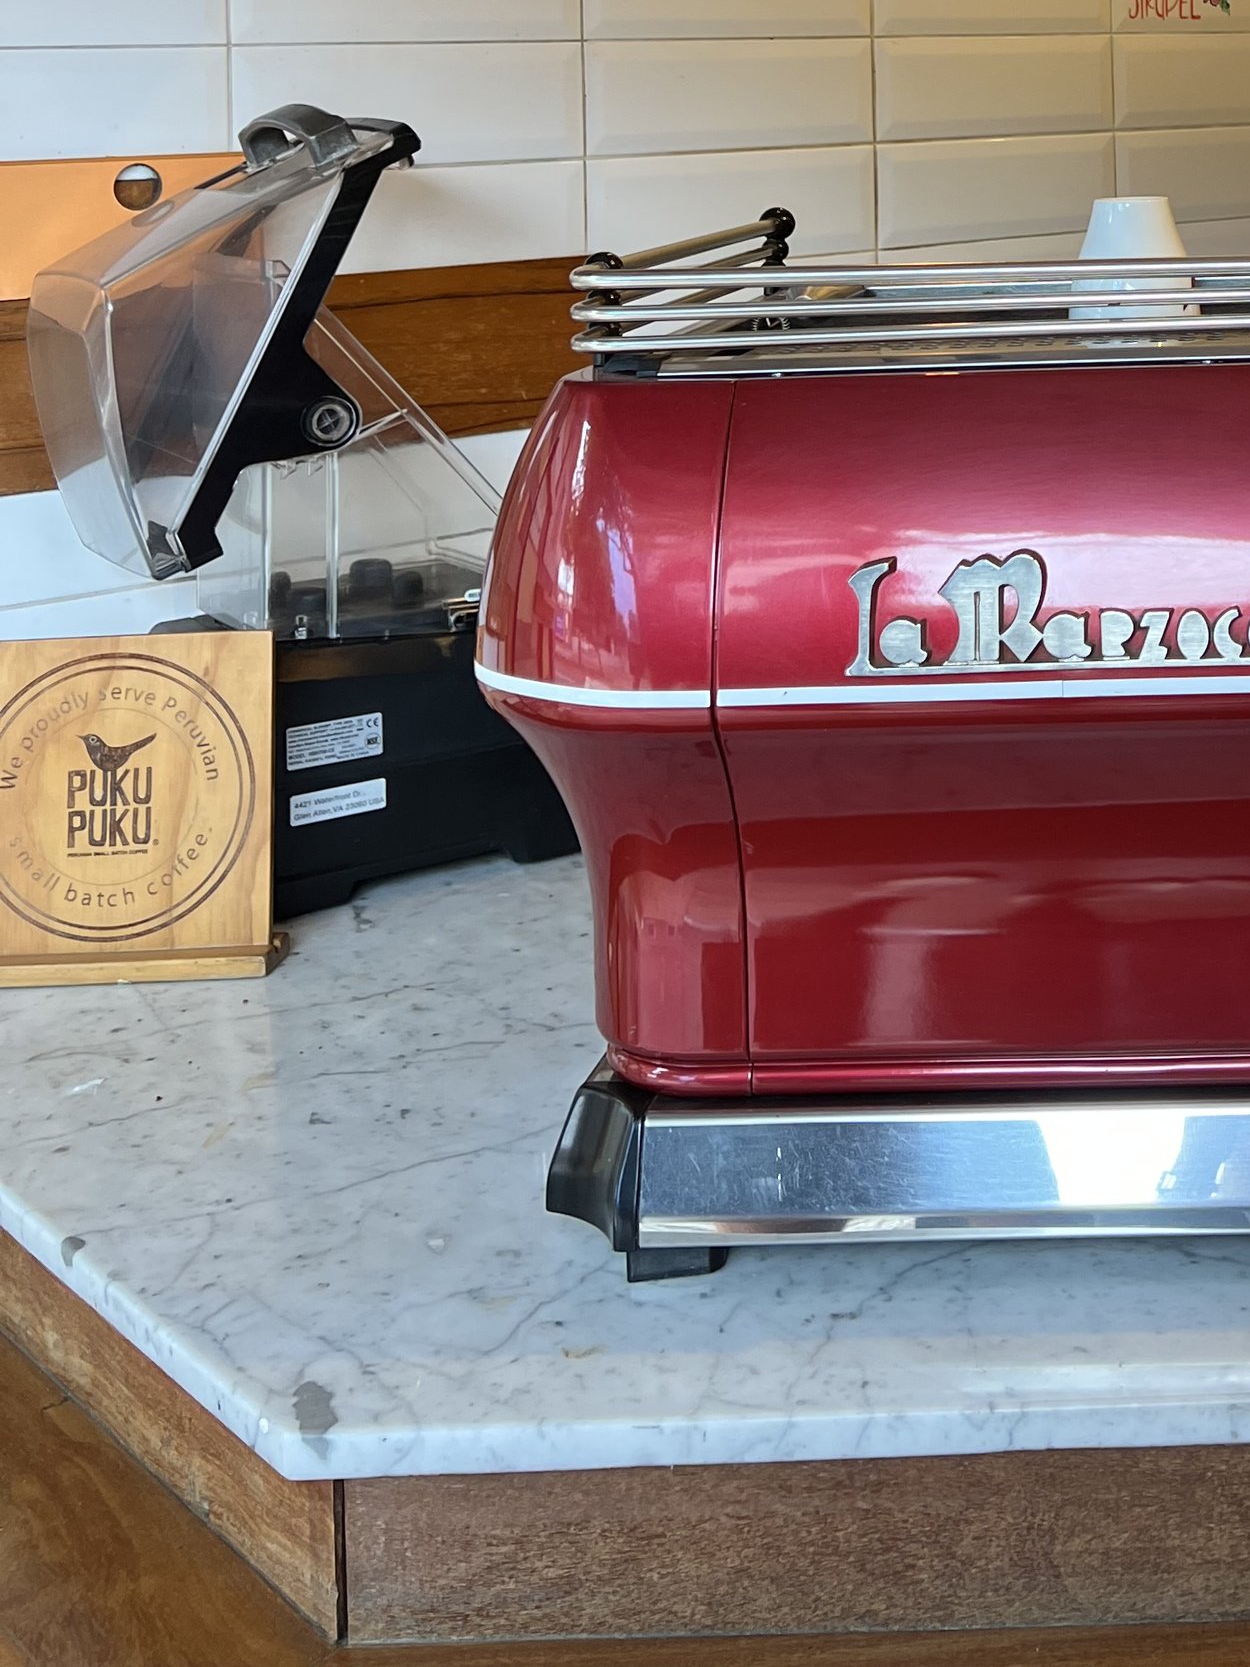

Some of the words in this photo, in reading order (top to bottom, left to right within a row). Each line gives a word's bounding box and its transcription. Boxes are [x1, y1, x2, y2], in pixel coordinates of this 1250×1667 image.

[844, 556, 930, 676] La
[0, 756, 23, 790] We
[20, 691, 89, 753] proudly
[99, 686, 156, 706] serve
[161, 696, 220, 781] Peruvian
[67, 767, 152, 809] PUKU
[67, 806, 152, 848] PUKU
[9, 837, 61, 894] small
[64, 882, 135, 908] batch
